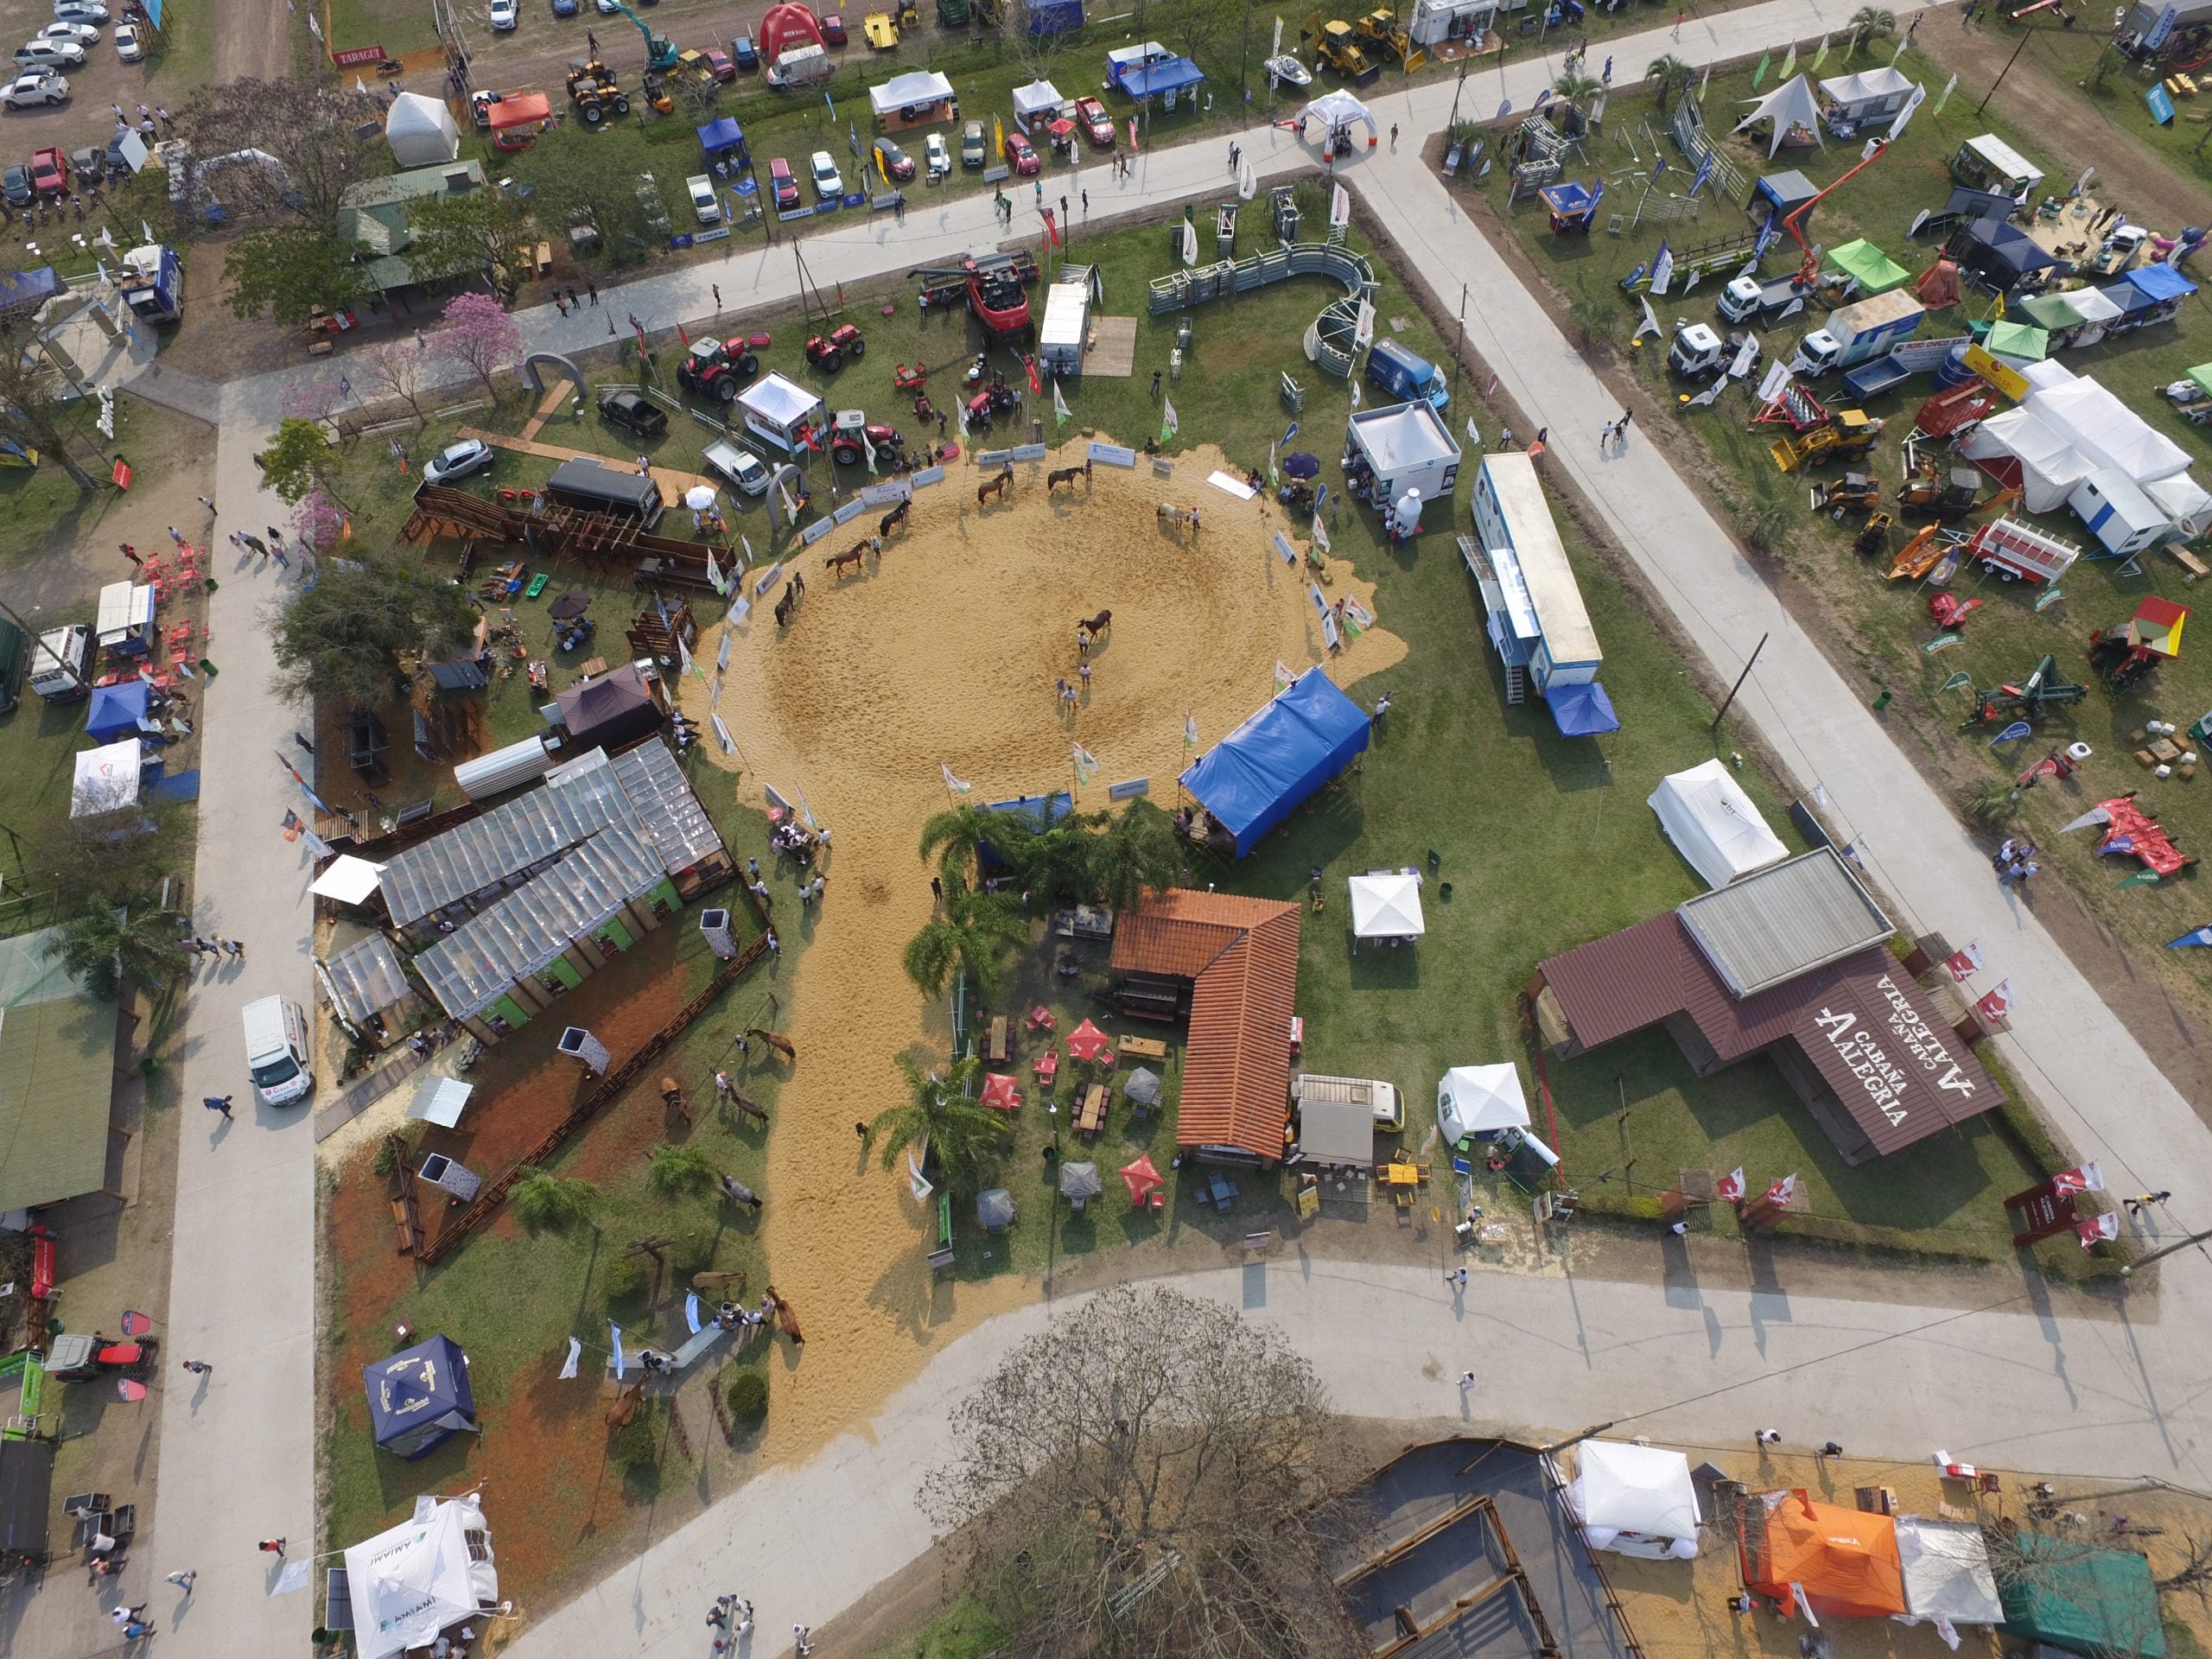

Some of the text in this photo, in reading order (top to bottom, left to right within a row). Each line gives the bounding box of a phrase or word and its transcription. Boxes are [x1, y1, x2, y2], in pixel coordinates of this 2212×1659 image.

[340, 48, 380, 64] TARAGUI
[1903, 341, 1920, 350] AGRO
[1877, 974, 1955, 1064] ALEGRIA
[1888, 1012, 1937, 1070] CABAÑA
[1834, 1040, 1908, 1127] ALEGRIA
[1854, 1031, 1908, 1095] CABAÑA
[370, 1541, 411, 1567] AMIAMI
[394, 1595, 436, 1624] AMIAMI
